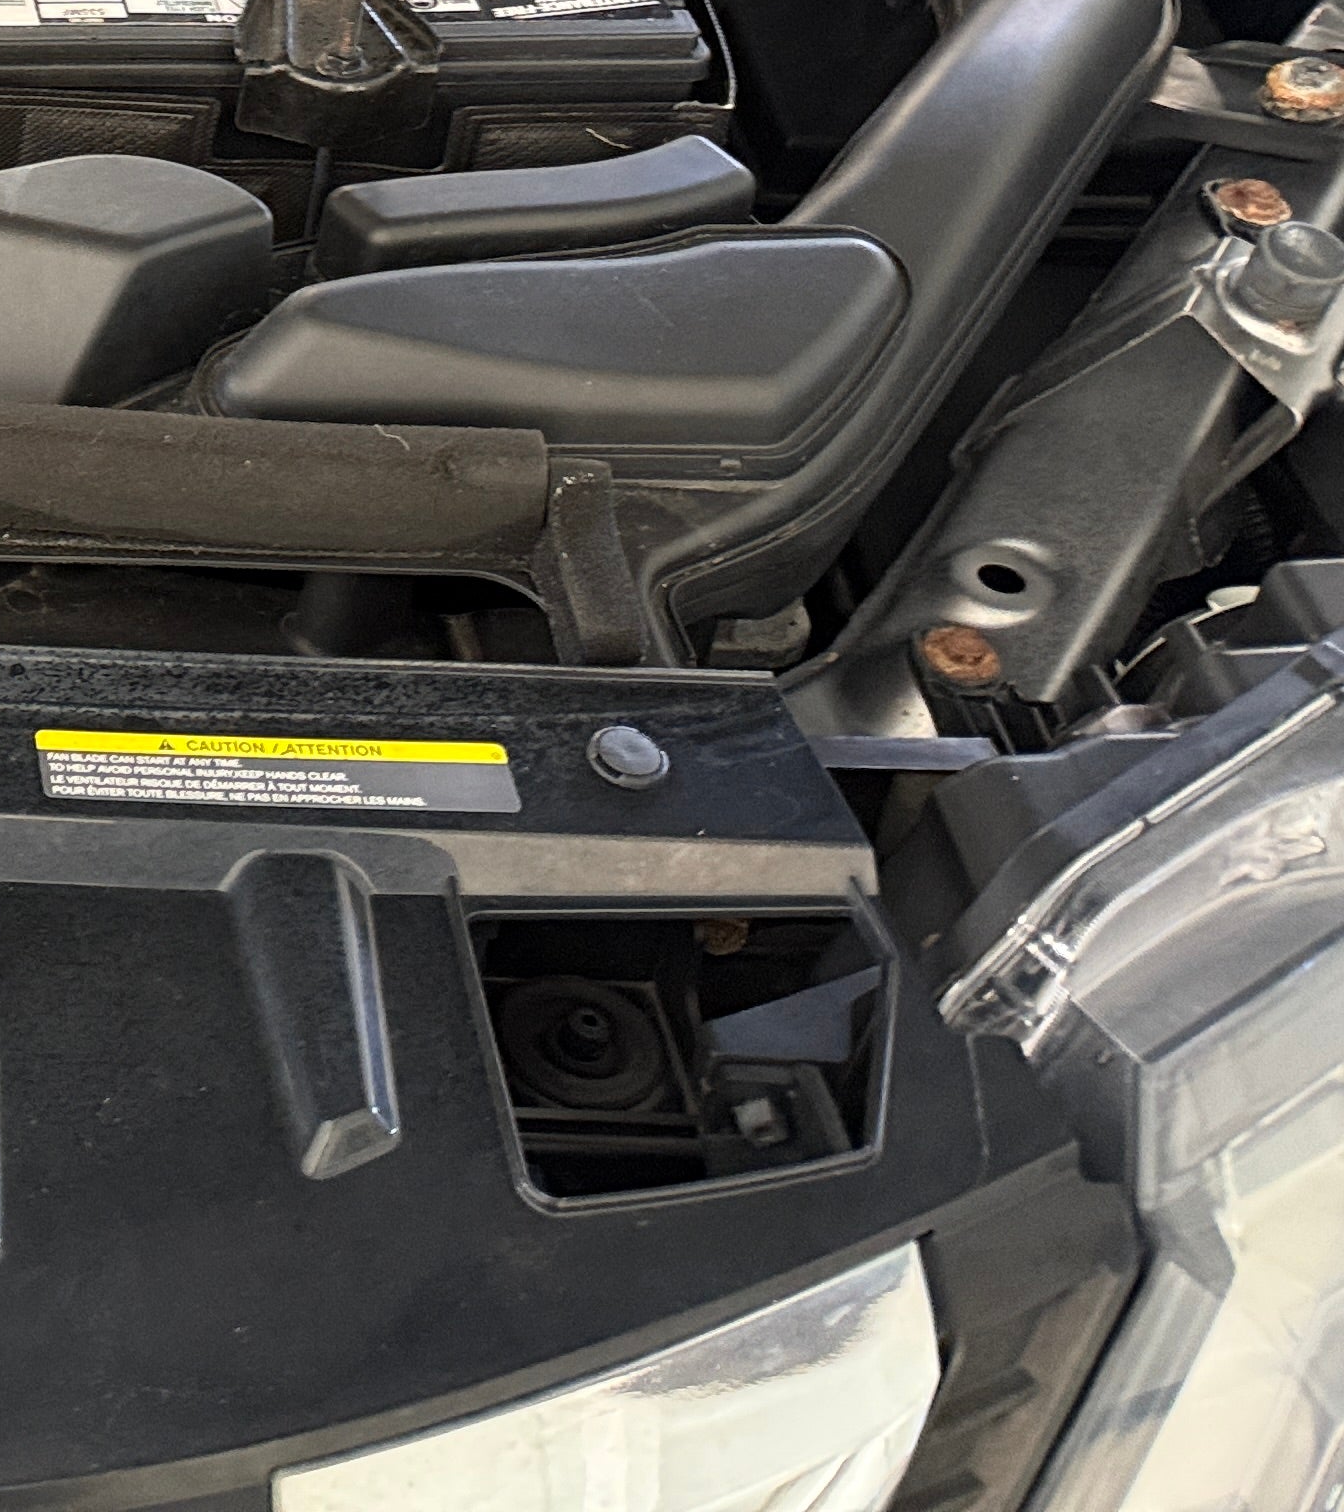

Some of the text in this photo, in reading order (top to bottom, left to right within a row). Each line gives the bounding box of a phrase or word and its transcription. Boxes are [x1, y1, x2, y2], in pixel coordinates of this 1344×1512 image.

[186, 739, 266, 753] CAUTION
[281, 743, 383, 756] ATTENTION
[47, 752, 69, 761] FAN
[71, 753, 108, 763] BLADE
[109, 755, 134, 764] CAN
[136, 756, 172, 765] START
[173, 757, 188, 766] AT
[188, 758, 213, 766] ANY
[48, 762, 64, 771] TO
[66, 763, 96, 773] HELP
[97, 764, 132, 774] AVOID
[134, 766, 194, 777] PERSONAL
[265, 771, 307, 780] HANDS
[50, 775, 65, 784] LE
[66, 776, 139, 786] VENTILATEUR
[141, 778, 183, 788] RISQUE
[185, 780, 202, 789] DE
[203, 779, 265, 791] DÉMARRER
[267, 780, 277, 791] À
[278, 783, 308, 792] TOUT
[51, 786, 85, 795] POUR
[87, 784, 126, 797] ÉVITER
[128, 789, 165, 798] TOUTE
[229, 792, 246, 801] NE
[247, 793, 272, 802] PAS
[272, 793, 290, 802] EN
[290, 794, 362, 805] APPROCHER
[363, 796, 386, 805] LES
